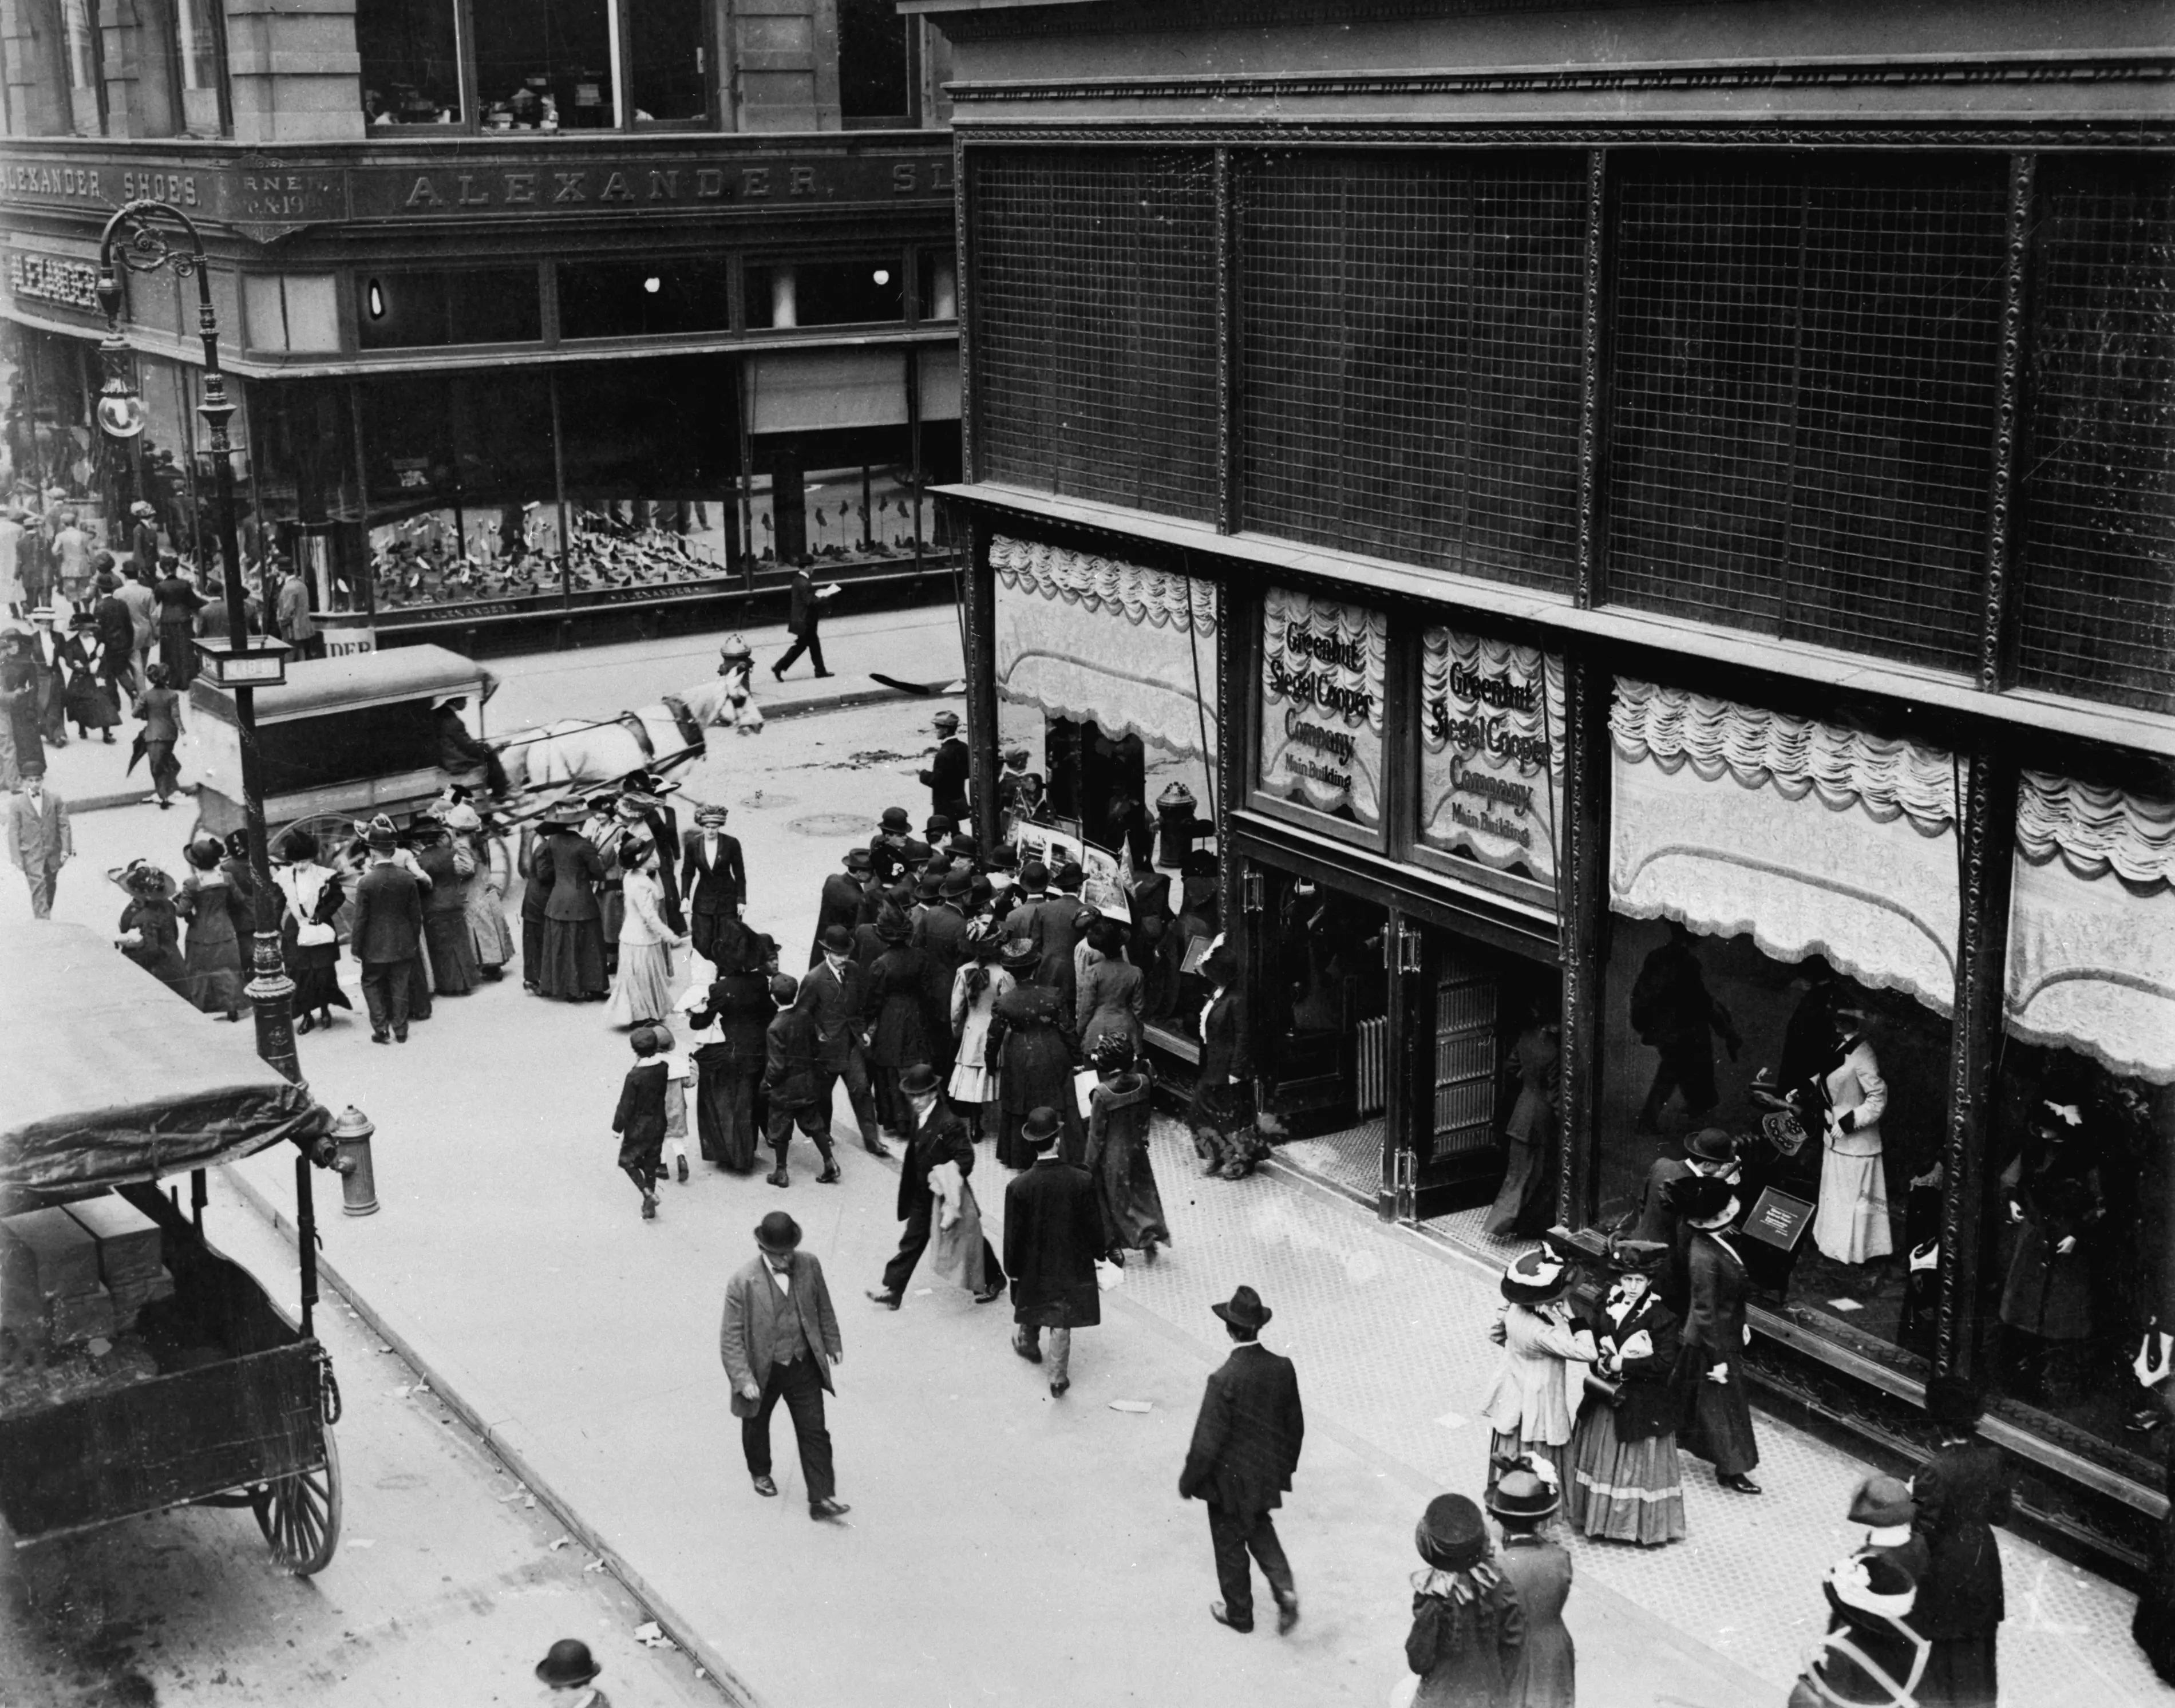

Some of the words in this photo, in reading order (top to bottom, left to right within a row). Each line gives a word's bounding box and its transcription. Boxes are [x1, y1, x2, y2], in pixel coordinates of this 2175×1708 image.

[430, 604, 508, 619] ALEXANDER
[619, 587, 693, 601] ALEXANDER
[1286, 622, 1359, 672] Greenhut
[1270, 659, 1316, 703] Siegel
[1316, 672, 1373, 722] Cooper
[1449, 662, 1535, 713] Greenhut
[1284, 708, 1356, 765] Company
[1431, 703, 1486, 750] Siegel
[1487, 717, 1553, 766] Cooper
[1285, 753, 1308, 776] Main
[1308, 761, 1352, 792] Building
[1449, 755, 1535, 817] Company
[1452, 802, 1478, 829] Main
[1480, 813, 1531, 849] Building
